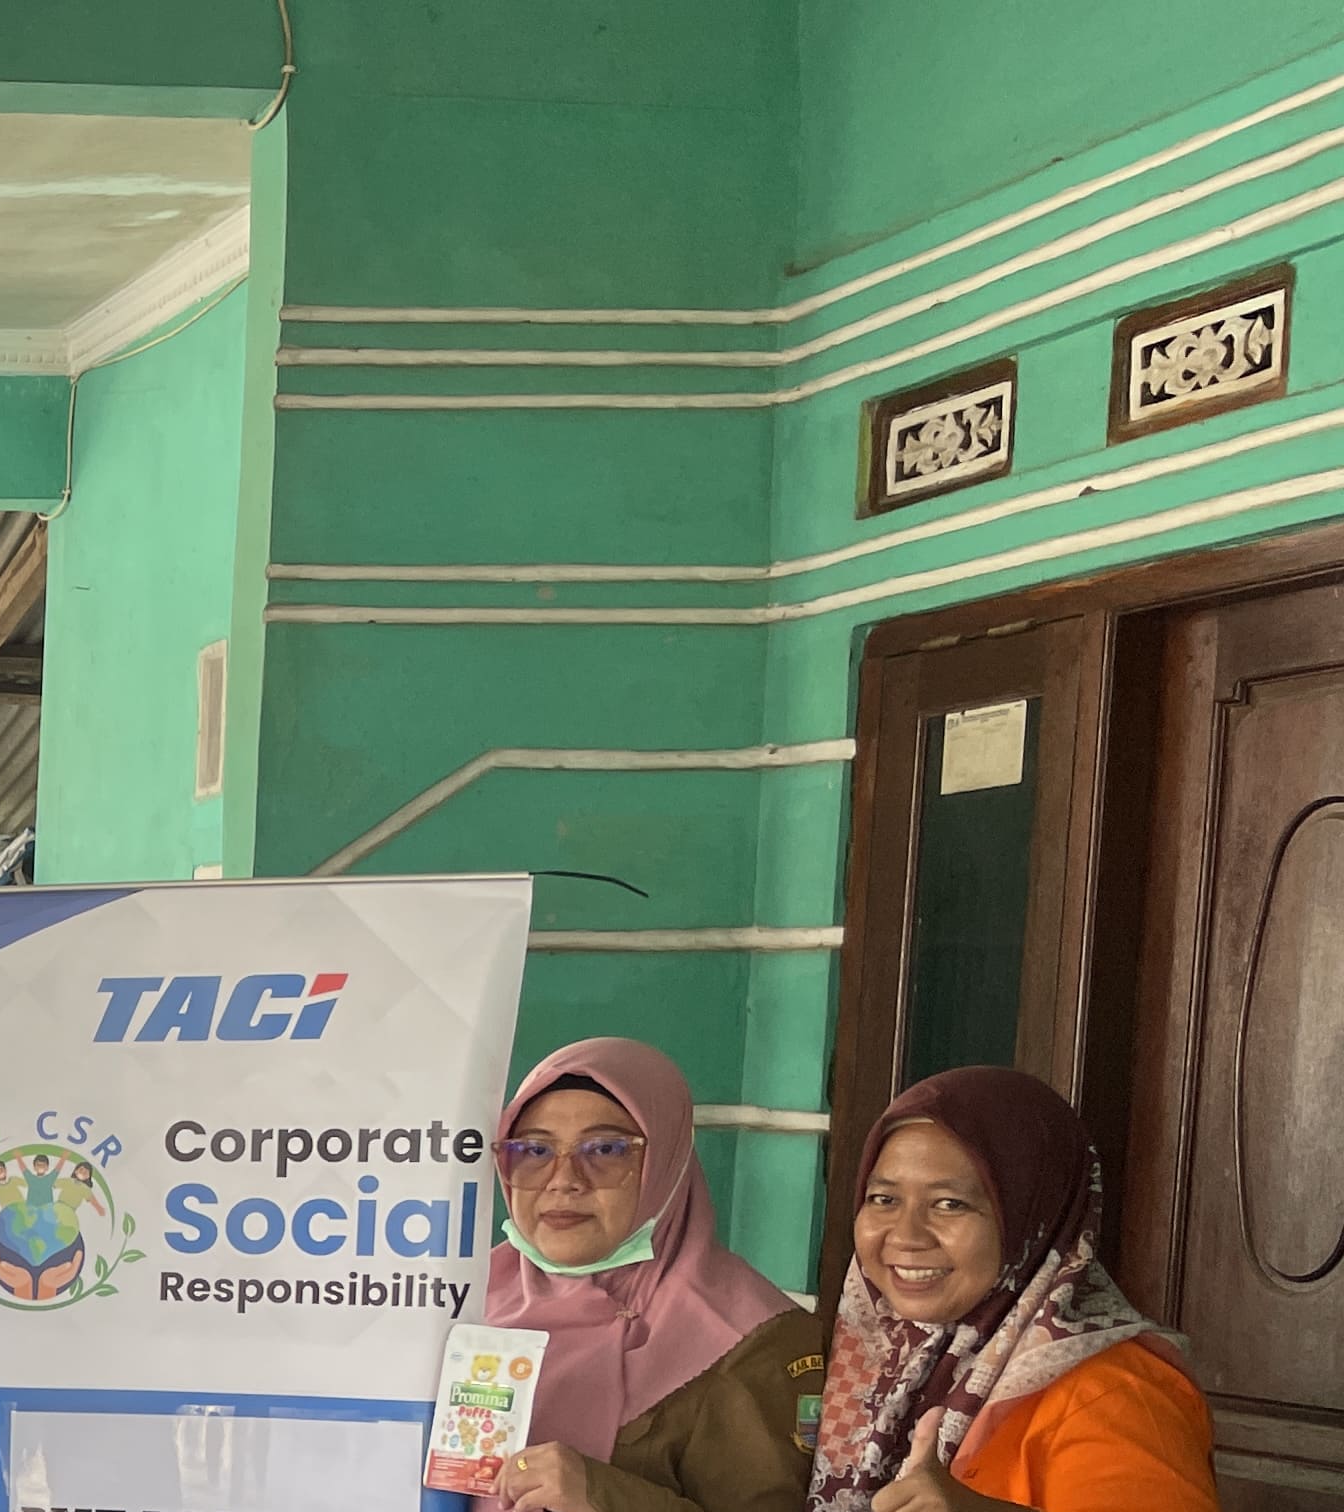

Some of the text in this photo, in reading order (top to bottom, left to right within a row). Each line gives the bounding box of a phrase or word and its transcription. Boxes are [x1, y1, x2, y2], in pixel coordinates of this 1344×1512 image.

[36, 1110, 122, 1168] CSR
[164, 1120, 483, 1177] Corporate
[164, 1175, 478, 1258] Social
[159, 1271, 471, 1318] Responsibility
[450, 1386, 509, 1408] Promina
